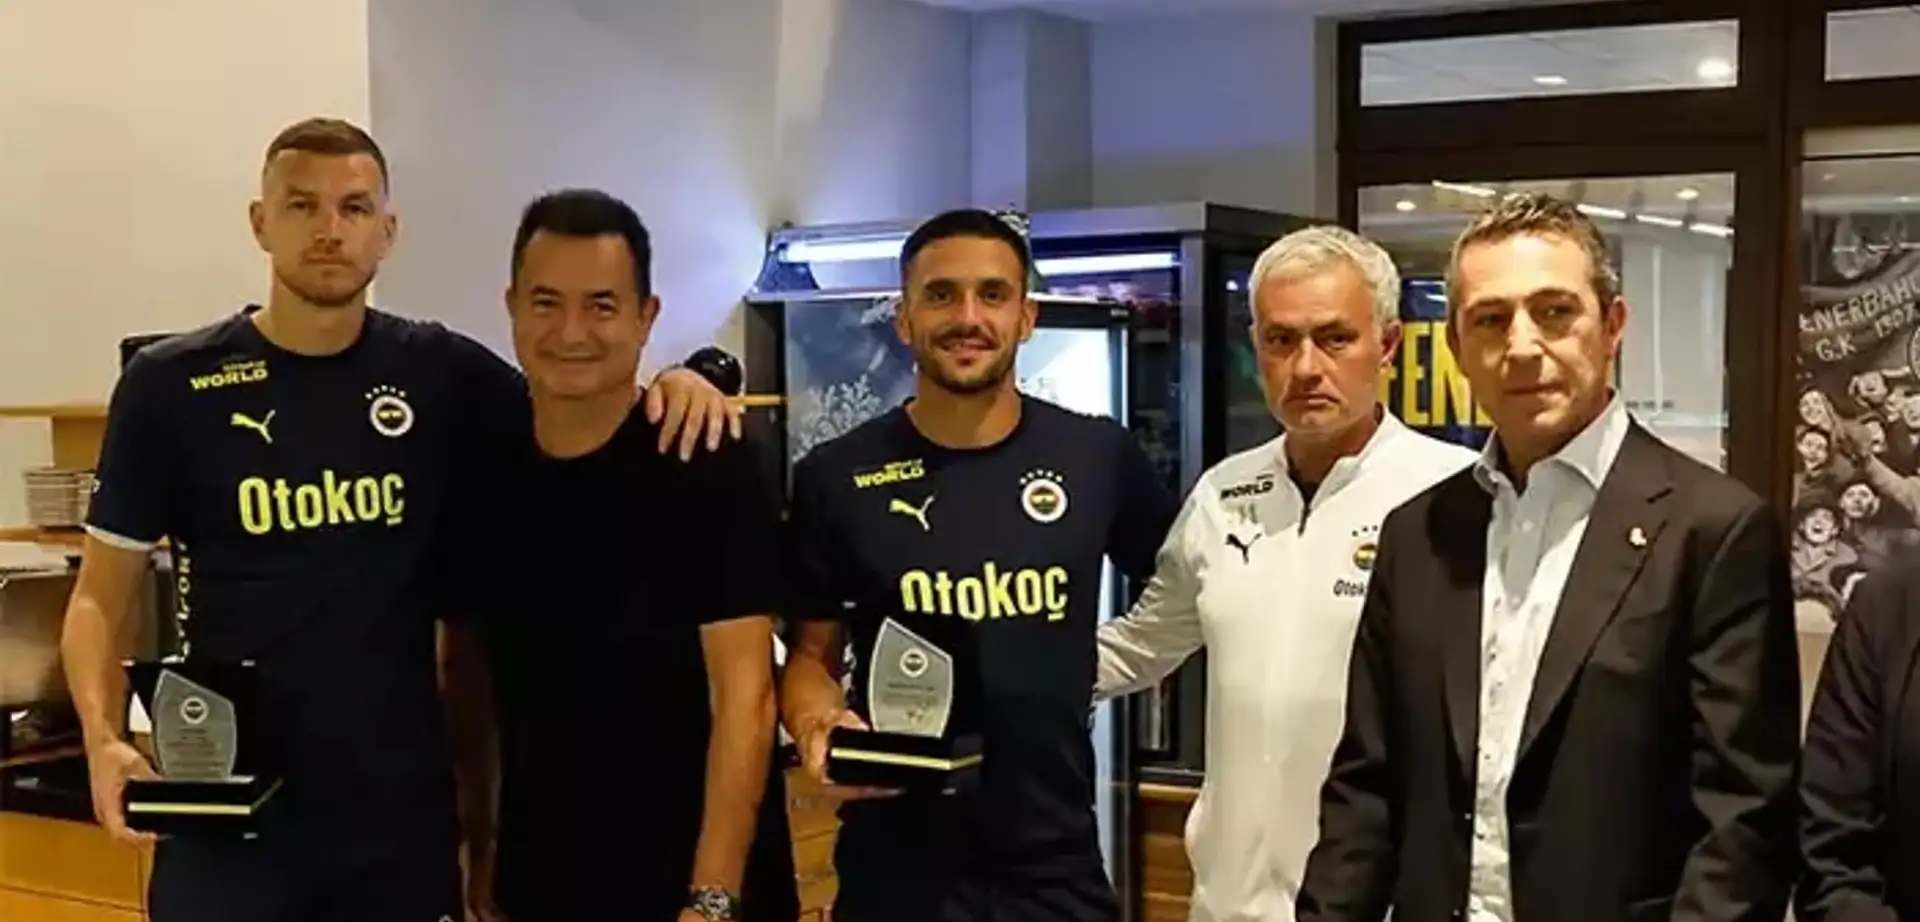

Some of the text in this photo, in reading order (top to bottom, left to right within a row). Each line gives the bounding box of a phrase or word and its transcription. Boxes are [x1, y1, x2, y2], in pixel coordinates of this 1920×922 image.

[190, 368, 268, 390] WORLD
[1378, 320, 1497, 426] EN
[854, 467, 925, 488] WORLD
[1220, 480, 1274, 500] WORLD
[235, 469, 404, 535] Otokoç
